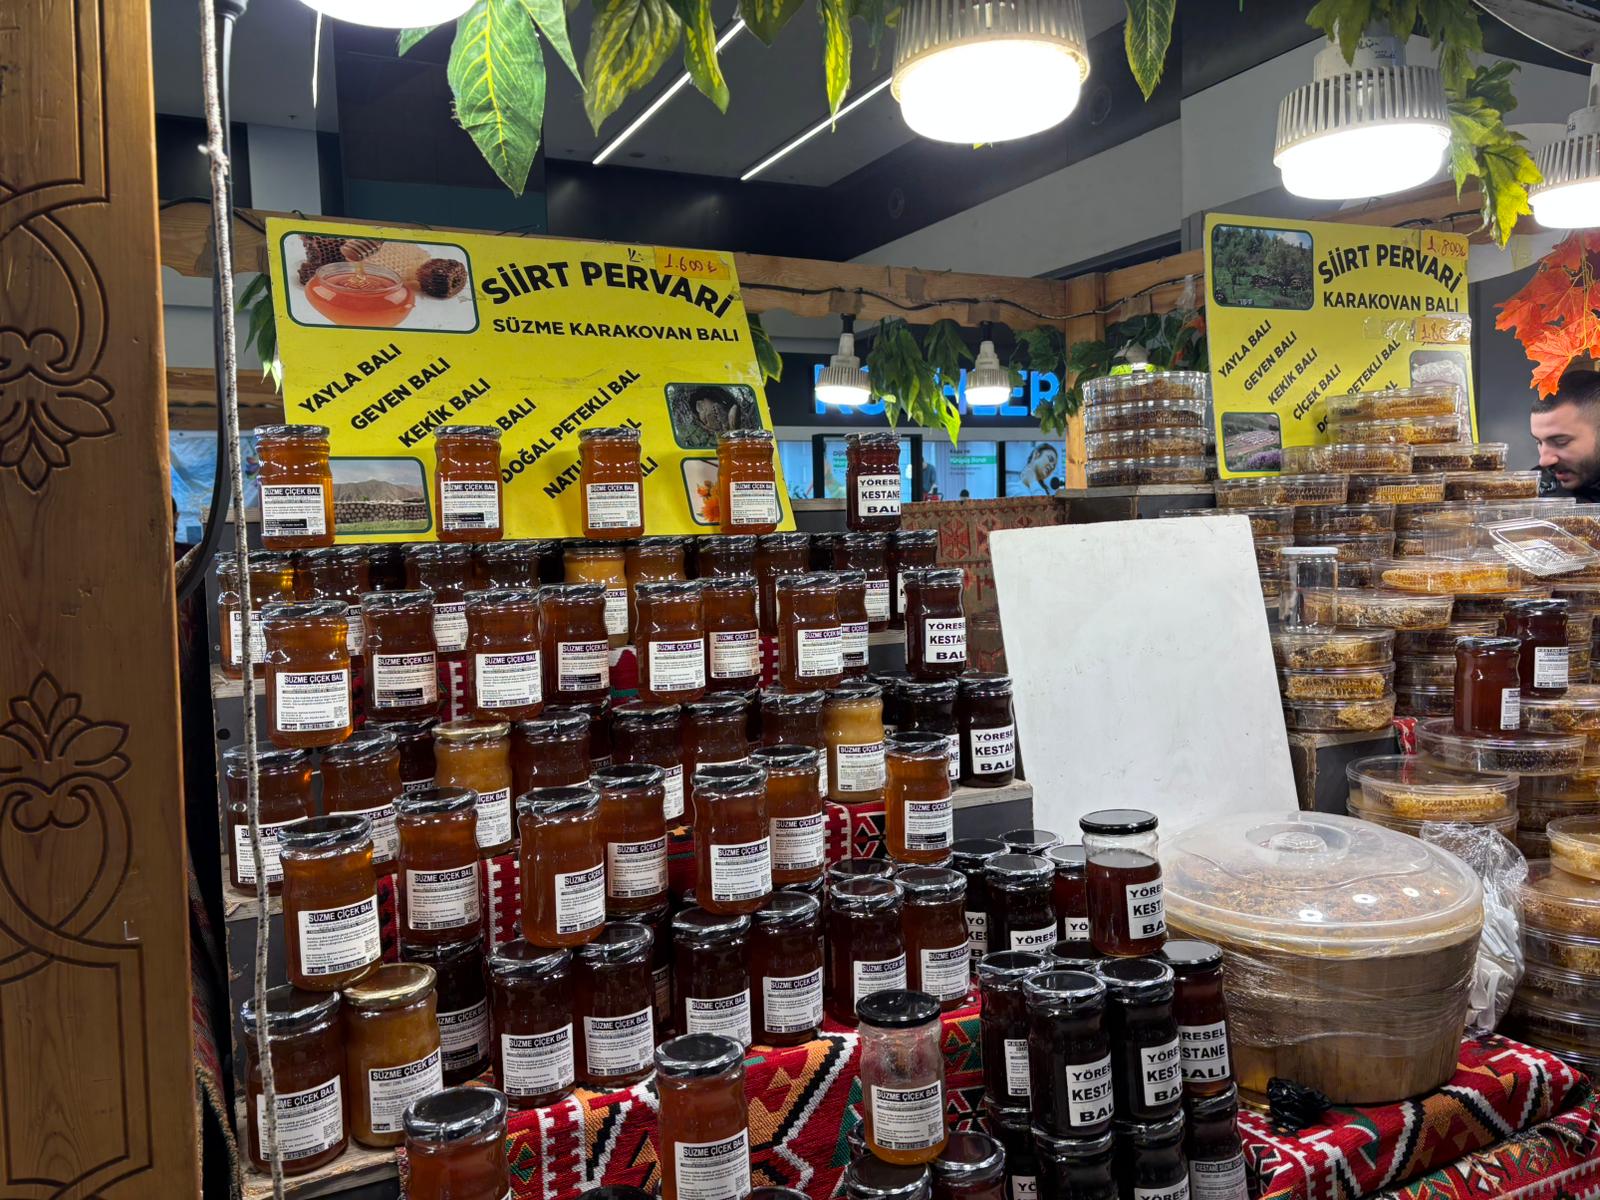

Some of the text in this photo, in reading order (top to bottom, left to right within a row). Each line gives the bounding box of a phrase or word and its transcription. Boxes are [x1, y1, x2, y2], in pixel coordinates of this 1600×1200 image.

[1318, 245, 1463, 293] SİİRT PERVARİ
[482, 261, 734, 319] SİİRT PERVARİ
[1323, 291, 1459, 312] KARAKOVAN BALI
[493, 317, 739, 342] SÜZME KARAKOVAN BALI
[1218, 319, 1273, 379] YAYLA BALI
[1381, 339, 1401, 363] BAL
[1244, 331, 1298, 391] GEVEN BALI
[298, 343, 402, 414] YAYLA BALI
[1268, 348, 1318, 405] KEKİK BALI
[350, 357, 452, 430] GEVEN BALI
[1293, 386, 1320, 421] ÇİÇEK
[1317, 364, 1342, 393] BALI
[398, 377, 492, 448] KEKİK BALI
[496, 397, 537, 431] BALI
[501, 369, 641, 484] DOĞAL PETEKLİ BAL
[402, 654, 422, 666] ÇİÇEK
[485, 655, 506, 665] SÜZME
[507, 654, 525, 665] ÇİÇEK
[936, 651, 965, 660] BAL
[284, 674, 308, 685] SÜZME
[309, 672, 330, 685] ÇİÇEK
[975, 731, 1013, 741] YÖRESE
[975, 742, 1014, 756] KESTAN
[741, 845, 758, 856] ÇİÇEK
[415, 873, 438, 884] SÜZME
[439, 869, 460, 883] ÇİÇEK
[565, 875, 587, 886] SÜZME
[1129, 883, 1163, 898] YÖRE
[309, 912, 335, 924] SÜZME
[337, 907, 360, 921] ÇİÇEK
[1133, 902, 1162, 916] KEST
[1142, 922, 1164, 935] BA
[771, 979, 792, 990] SÜZME
[793, 977, 809, 989] ÇİÇEK
[692, 999, 713, 1010] SÜZME
[714, 995, 733, 1009] ÇİÇEK
[615, 1015, 634, 1030] ÇİÇEK
[509, 1038, 532, 1048] SÜZME
[533, 1034, 555, 1048] ÇİÇEK
[1180, 1028, 1225, 1041] RESEL
[1147, 1046, 1179, 1063] YÖRE
[1182, 1044, 1225, 1060] STANE
[373, 1069, 402, 1080] SÜZME
[403, 1061, 428, 1077] ÇİÇEK
[1072, 1061, 1111, 1081] YÖRES
[1147, 1064, 1180, 1082] KEST
[294, 1091, 320, 1107] ÇİÇEK
[877, 1089, 901, 1101] SÜZME
[901, 1085, 925, 1101] ÇİÇEK
[1072, 1083, 1112, 1102] KESTA
[1080, 1103, 1113, 1122] BAL
[683, 1147, 709, 1158] SÜZME
[710, 1142, 732, 1156] ÇİÇEK
